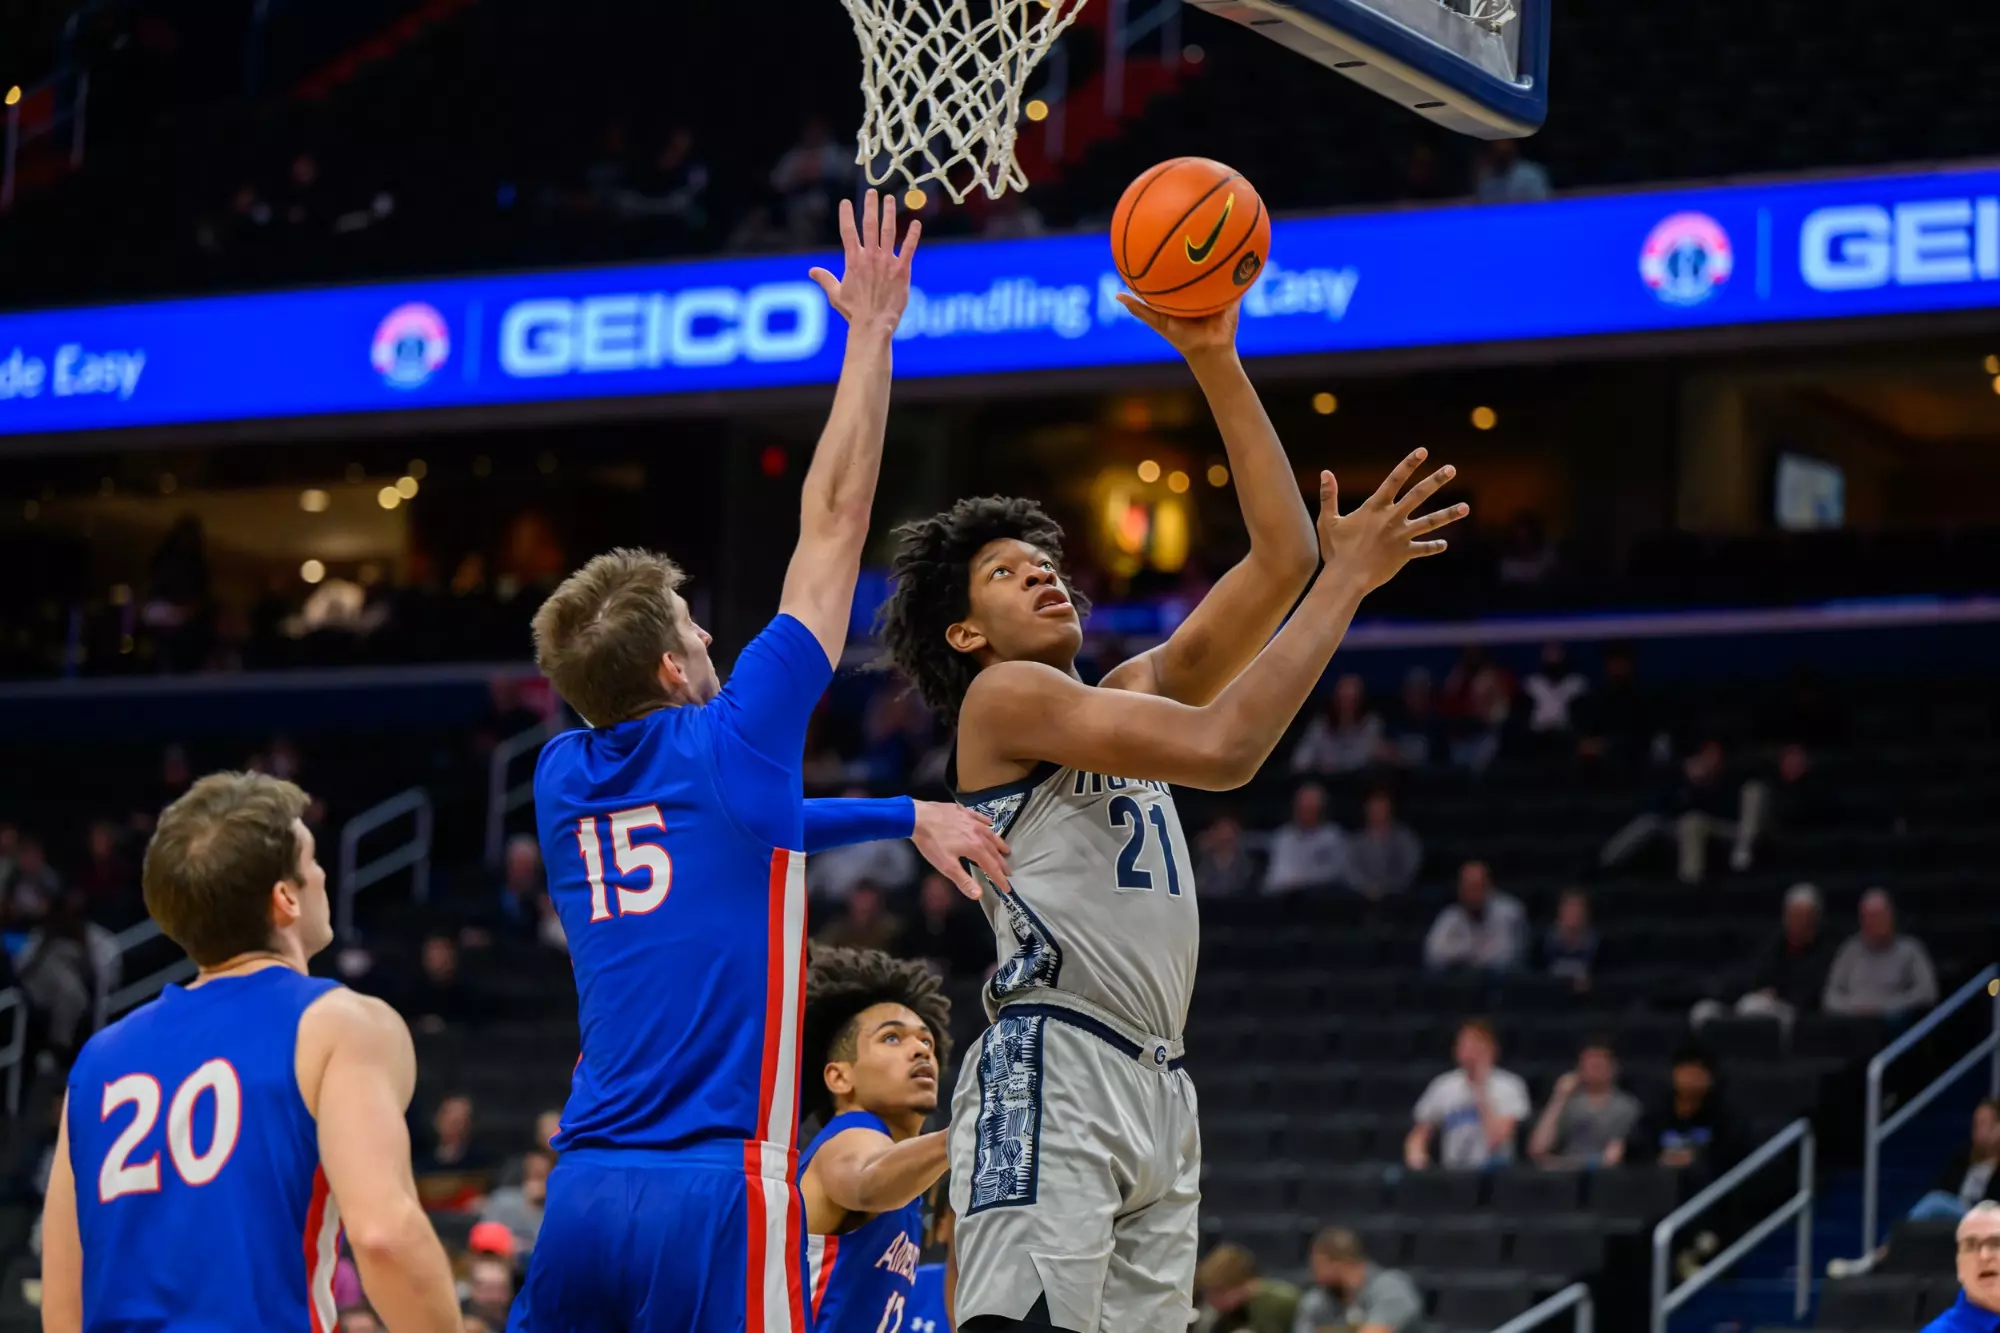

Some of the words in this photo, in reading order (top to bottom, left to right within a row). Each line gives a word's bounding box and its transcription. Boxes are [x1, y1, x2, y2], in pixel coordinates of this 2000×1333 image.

[53, 342, 147, 400] Easy
[501, 282, 829, 376] GEICO
[1242, 263, 1358, 321] Easy
[575, 803, 673, 923] 15
[1107, 794, 1182, 898] 21
[98, 1057, 242, 1204] 20
